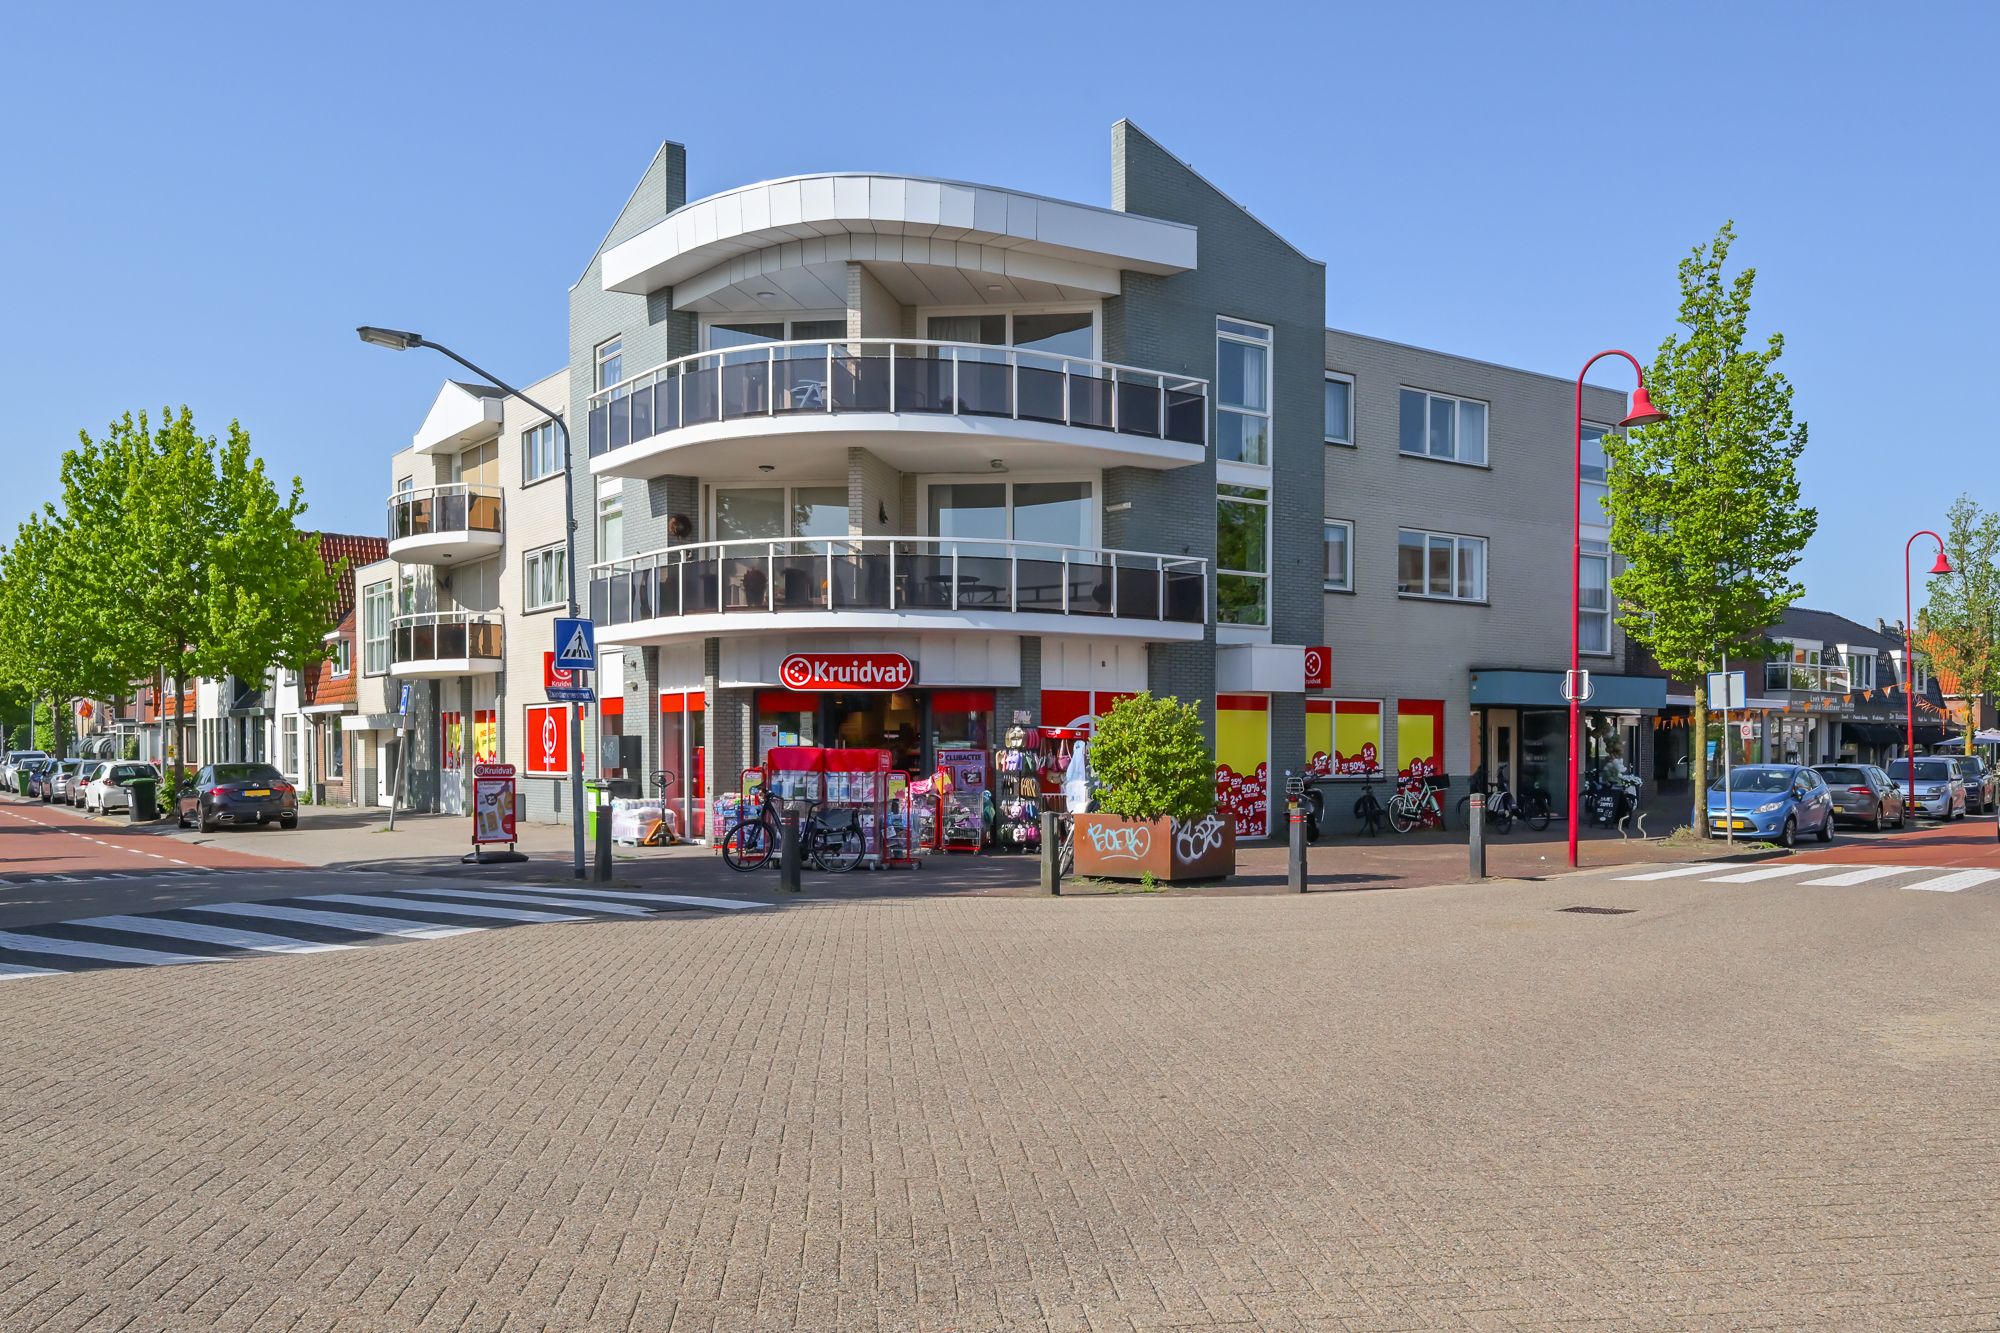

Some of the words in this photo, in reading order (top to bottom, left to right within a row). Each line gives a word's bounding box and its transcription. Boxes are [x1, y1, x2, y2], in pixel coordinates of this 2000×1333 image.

[814, 660, 906, 682] Kruidvat
[1363, 747, 1374, 757] 1+1
[484, 767, 513, 775] Kruidvat
[1350, 762, 1365, 770] 50%
[1411, 763, 1422, 772] 1+1
[1241, 783, 1260, 794] 50%
[1249, 821, 1263, 832] 2+1
